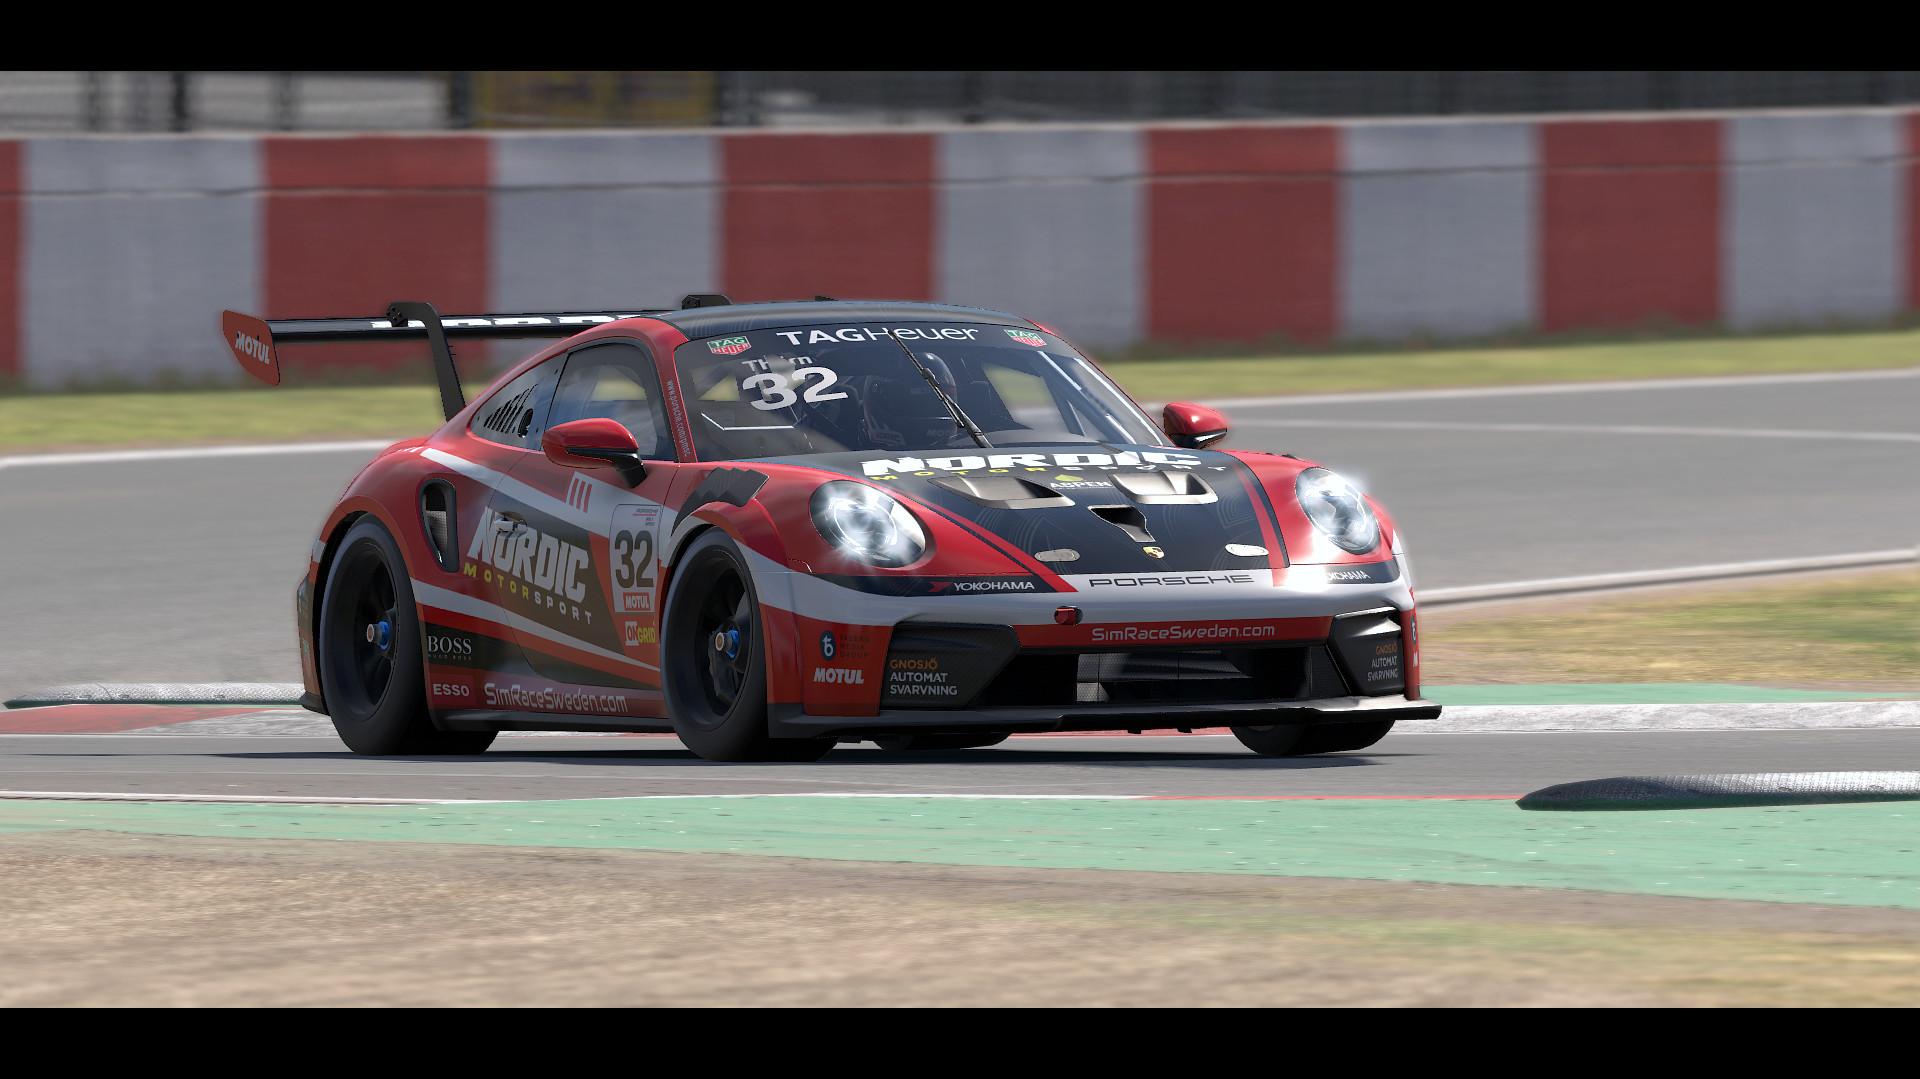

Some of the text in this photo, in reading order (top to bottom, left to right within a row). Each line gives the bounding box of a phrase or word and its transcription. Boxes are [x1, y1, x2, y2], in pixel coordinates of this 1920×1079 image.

[235, 329, 270, 365] MOTUL
[711, 336, 747, 347] TAG
[711, 344, 750, 354] HEUER
[742, 366, 849, 411] 32
[859, 451, 1202, 476] NORDIC
[467, 506, 589, 603] NORDIC
[614, 529, 655, 589] 32
[953, 580, 1035, 592] YOKOHAMA
[1088, 574, 1255, 588] PORSCHE
[463, 561, 592, 625] MOTORSPORT
[625, 595, 650, 609] MOTUL
[1092, 624, 1275, 642] SimRaceSweden.com
[428, 635, 472, 655] BOSS
[890, 656, 938, 670] GNOSJÖ
[1371, 655, 1398, 669] AUTOMAT
[813, 667, 864, 685] MOTUL
[890, 671, 948, 683] AUTOMAT
[1367, 668, 1399, 682] SVARVNING
[433, 683, 470, 697] ESSO
[890, 684, 958, 696] SVARVNING
[484, 682, 629, 713] SimRaceSweden.com
